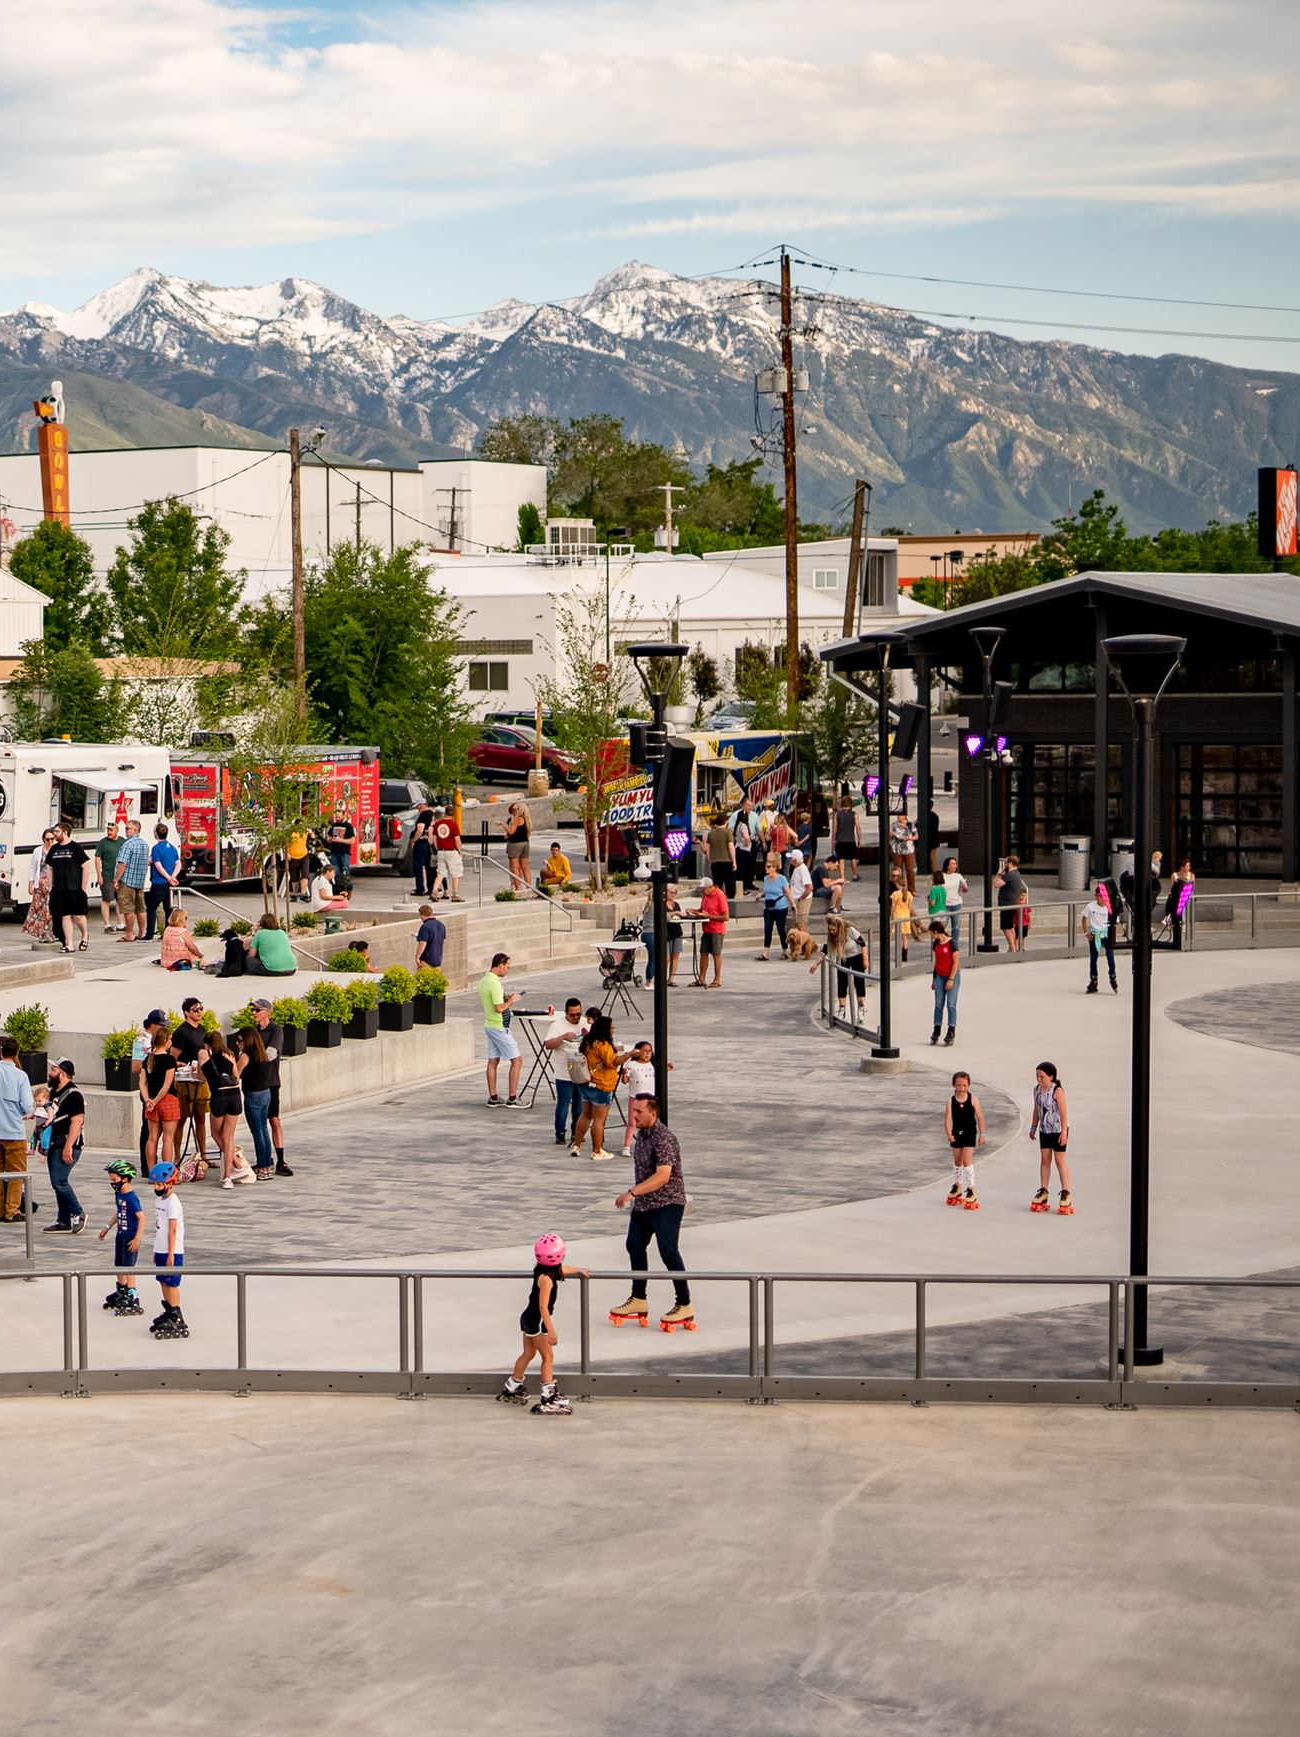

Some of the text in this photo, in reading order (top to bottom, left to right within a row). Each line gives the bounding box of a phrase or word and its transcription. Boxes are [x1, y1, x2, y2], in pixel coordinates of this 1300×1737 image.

[640, 789, 654, 803] YU
[749, 776, 769, 805] YUM
[769, 764, 790, 795] YUM
